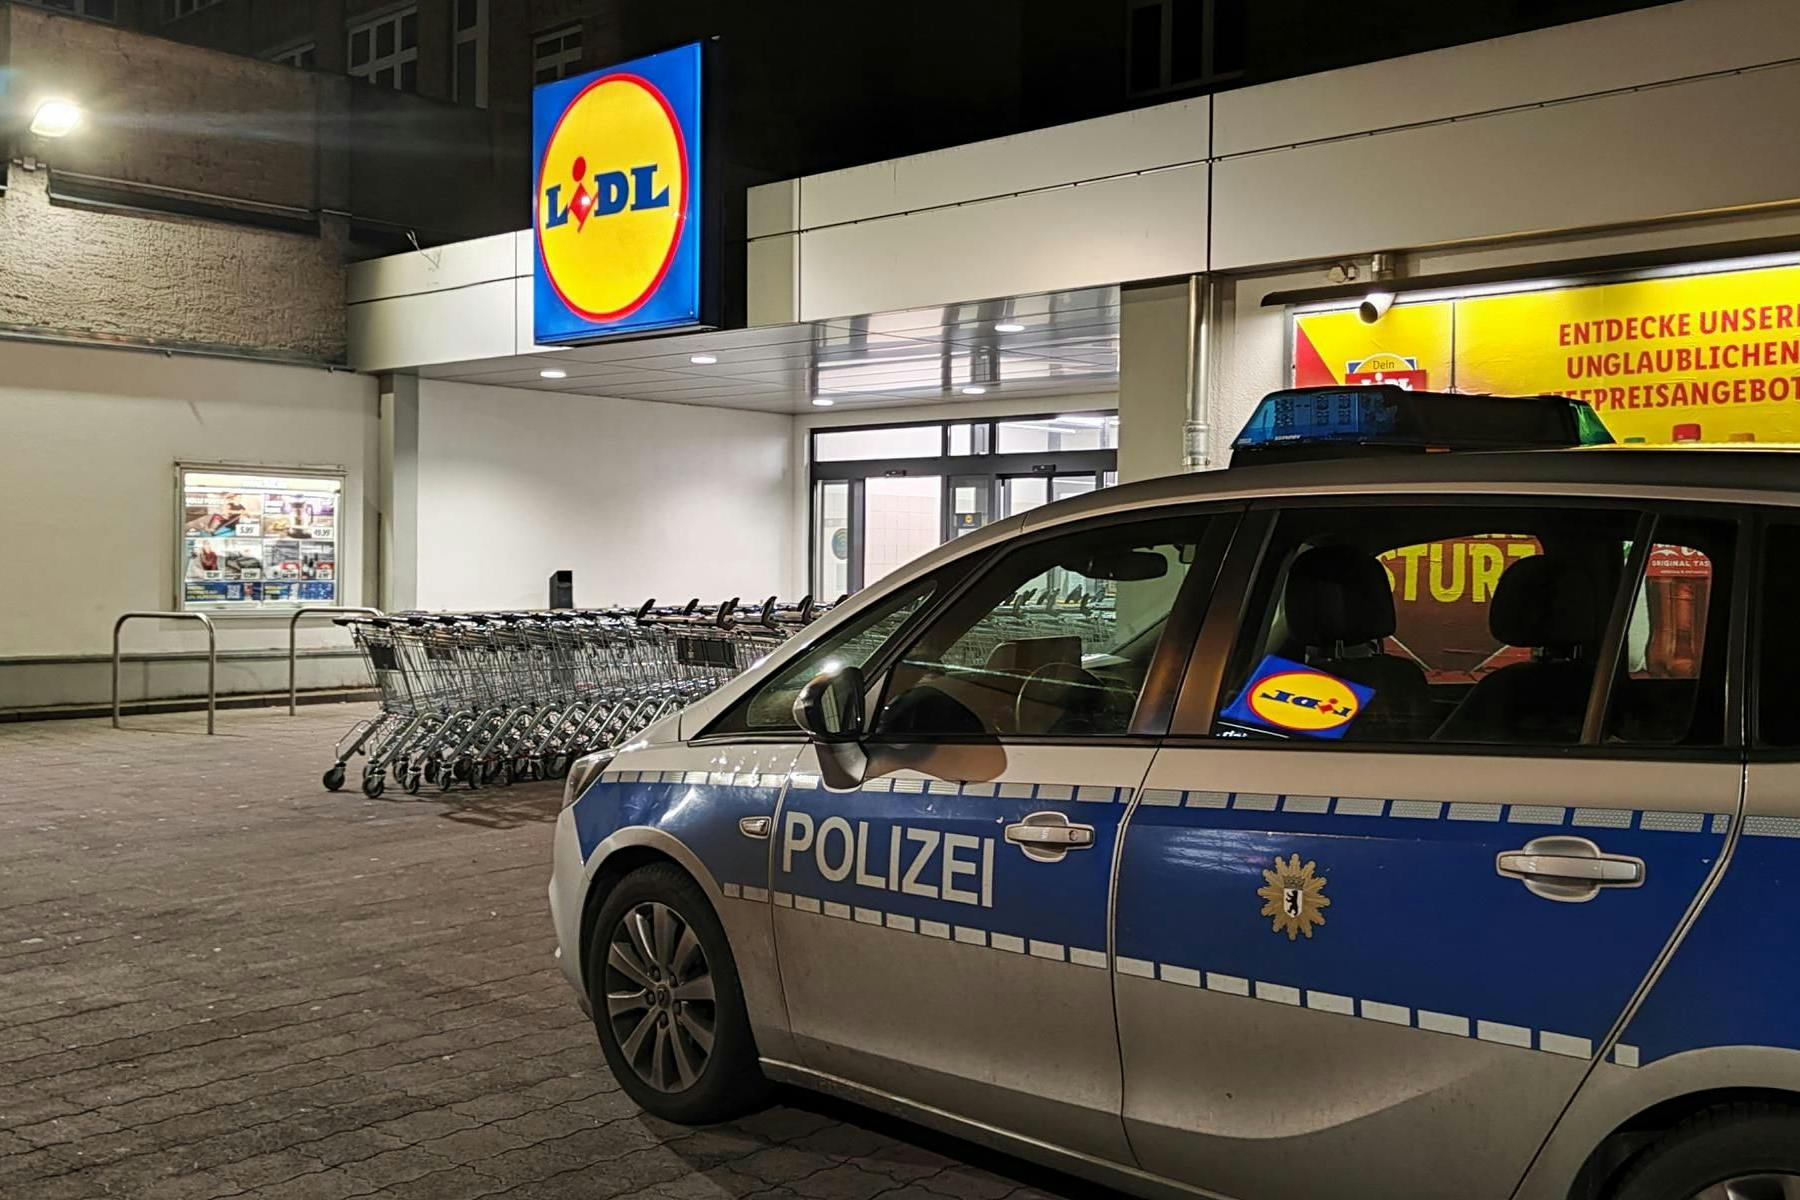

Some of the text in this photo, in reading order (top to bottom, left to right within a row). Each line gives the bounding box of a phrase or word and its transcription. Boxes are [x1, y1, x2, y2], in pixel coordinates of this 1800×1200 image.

[1559, 313, 1690, 346] ENTDECKE
[1567, 340, 1799, 379] UNGLAUBLICHEN
[782, 811, 993, 908] POLIZEI
